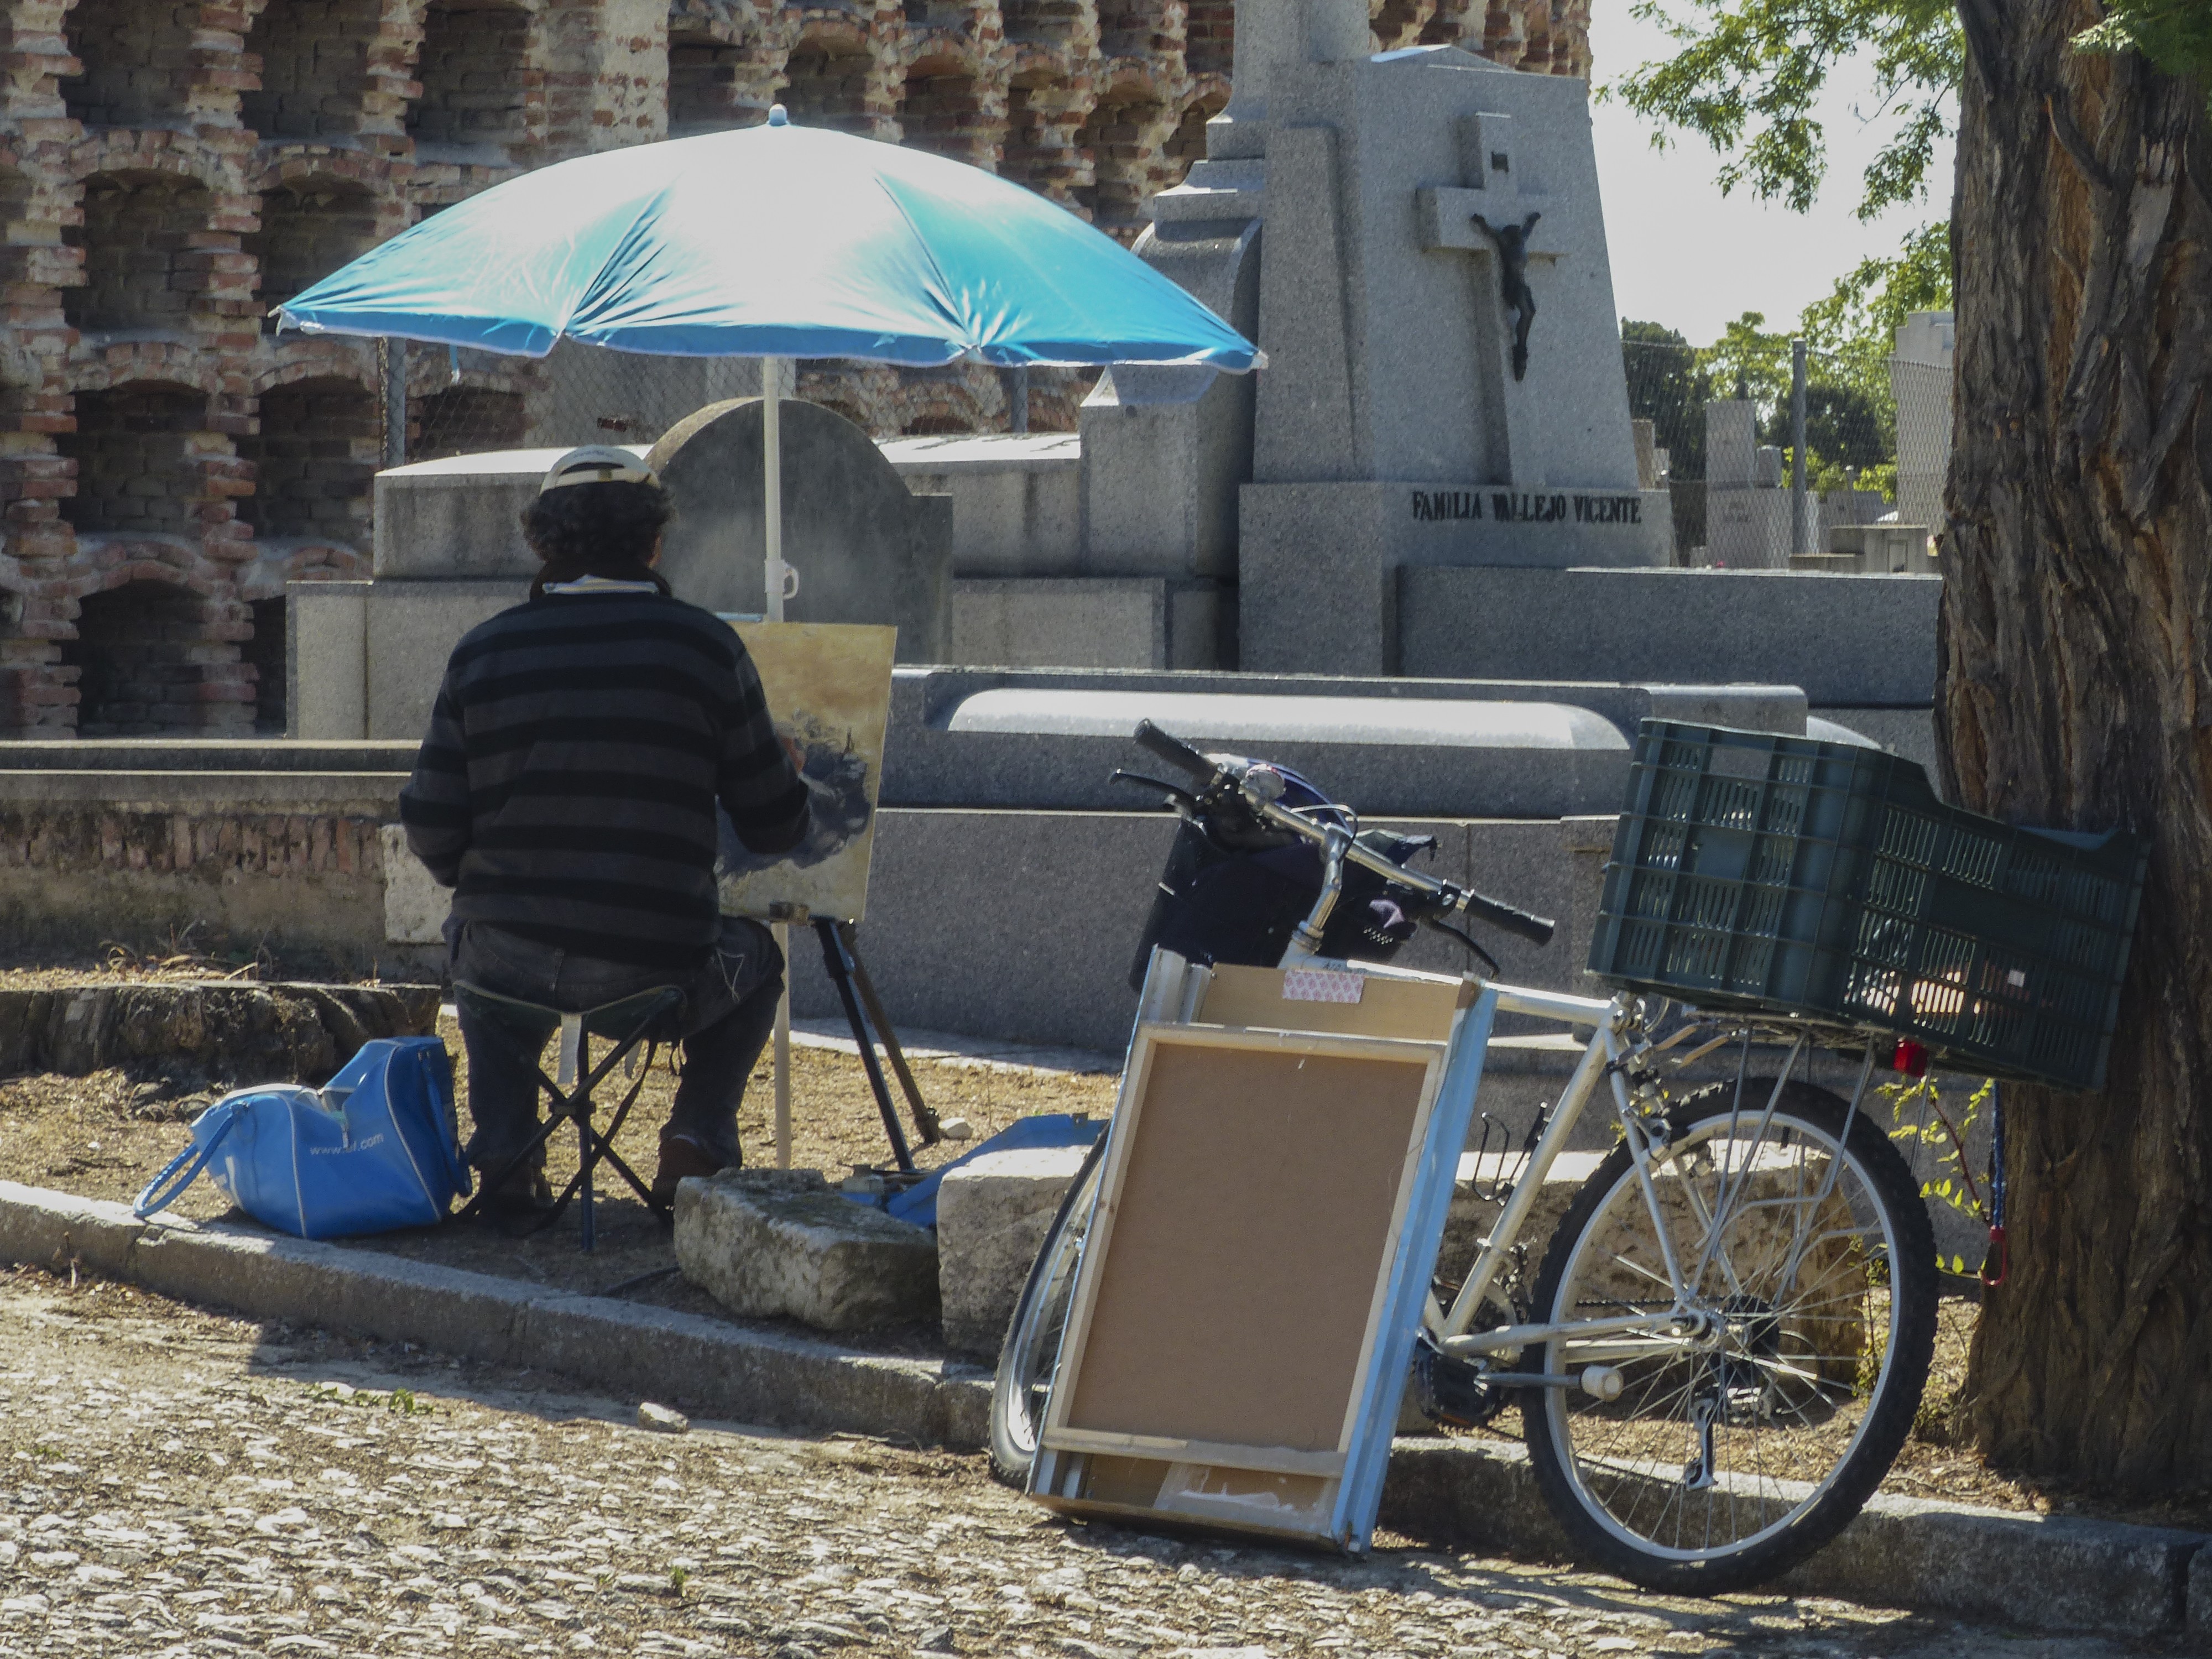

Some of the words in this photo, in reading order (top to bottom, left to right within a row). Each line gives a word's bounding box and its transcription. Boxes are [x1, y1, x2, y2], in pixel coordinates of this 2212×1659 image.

[1413, 492, 1483, 521] FAMILIA
[1492, 493, 1566, 523] VALLEJO
[1572, 495, 1641, 525] VICENTE
